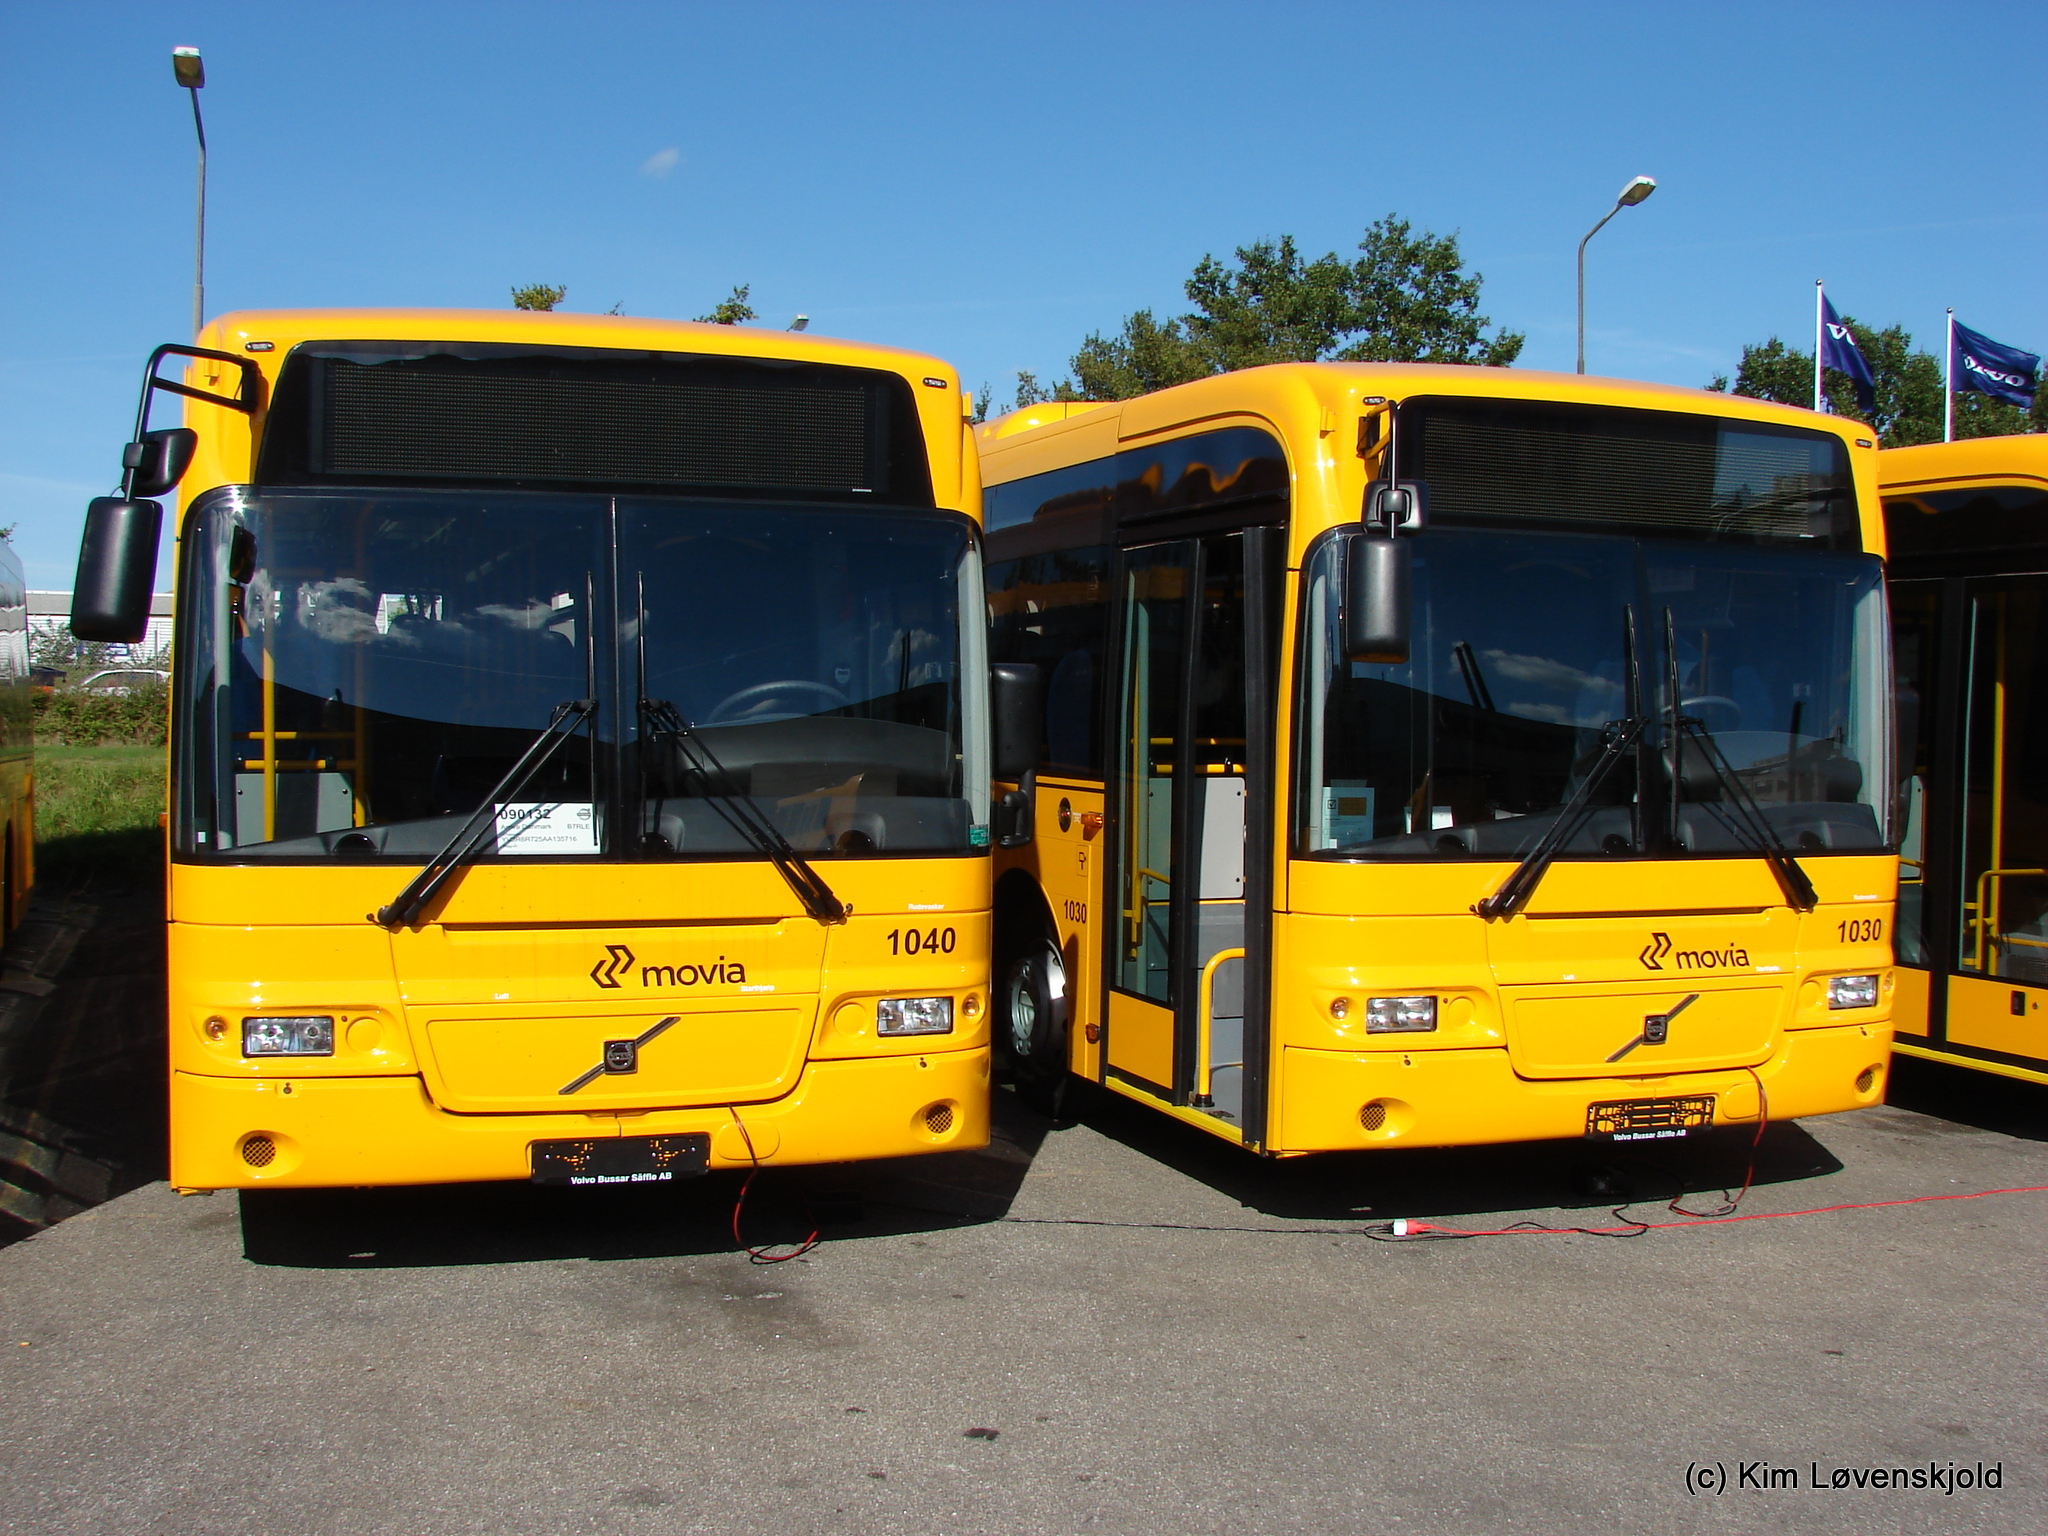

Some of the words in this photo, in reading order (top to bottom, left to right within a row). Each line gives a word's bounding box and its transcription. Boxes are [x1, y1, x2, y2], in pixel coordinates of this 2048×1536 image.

[501, 808, 551, 820] 090132
[1064, 898, 1087, 924] 1030
[886, 927, 956, 956] 1040
[1837, 918, 1882, 943] 1030
[1675, 942, 1750, 969] movia
[642, 955, 747, 987] movia
[1613, 1133, 1632, 1141] Volvo
[1632, 1132, 1656, 1140] Bussar
[1676, 1129, 1687, 1137] AB
[571, 1176, 596, 1185] Volvo
[597, 1175, 630, 1184] Bussar
[658, 1171, 673, 1180] AB
